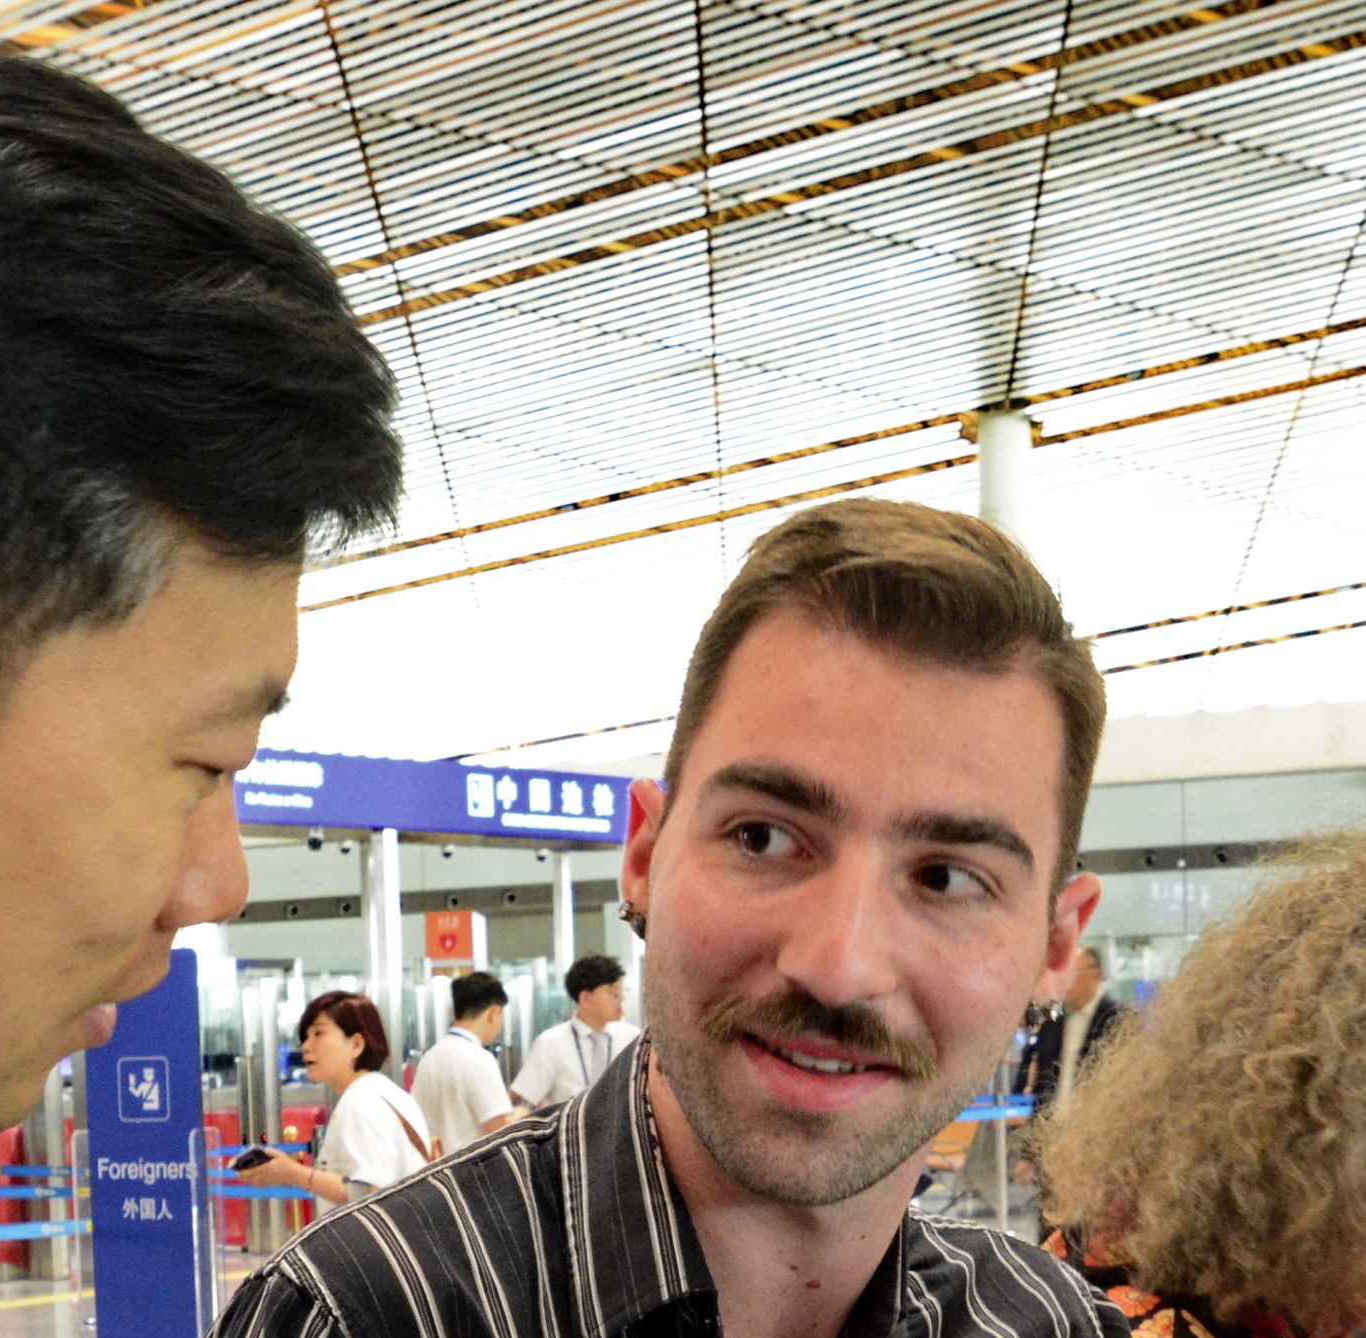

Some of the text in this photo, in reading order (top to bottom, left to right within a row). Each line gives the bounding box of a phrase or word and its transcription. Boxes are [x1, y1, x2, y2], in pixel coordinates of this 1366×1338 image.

[97, 1157, 198, 1184] Foreigners
[123, 1199, 173, 1220] 外国人
